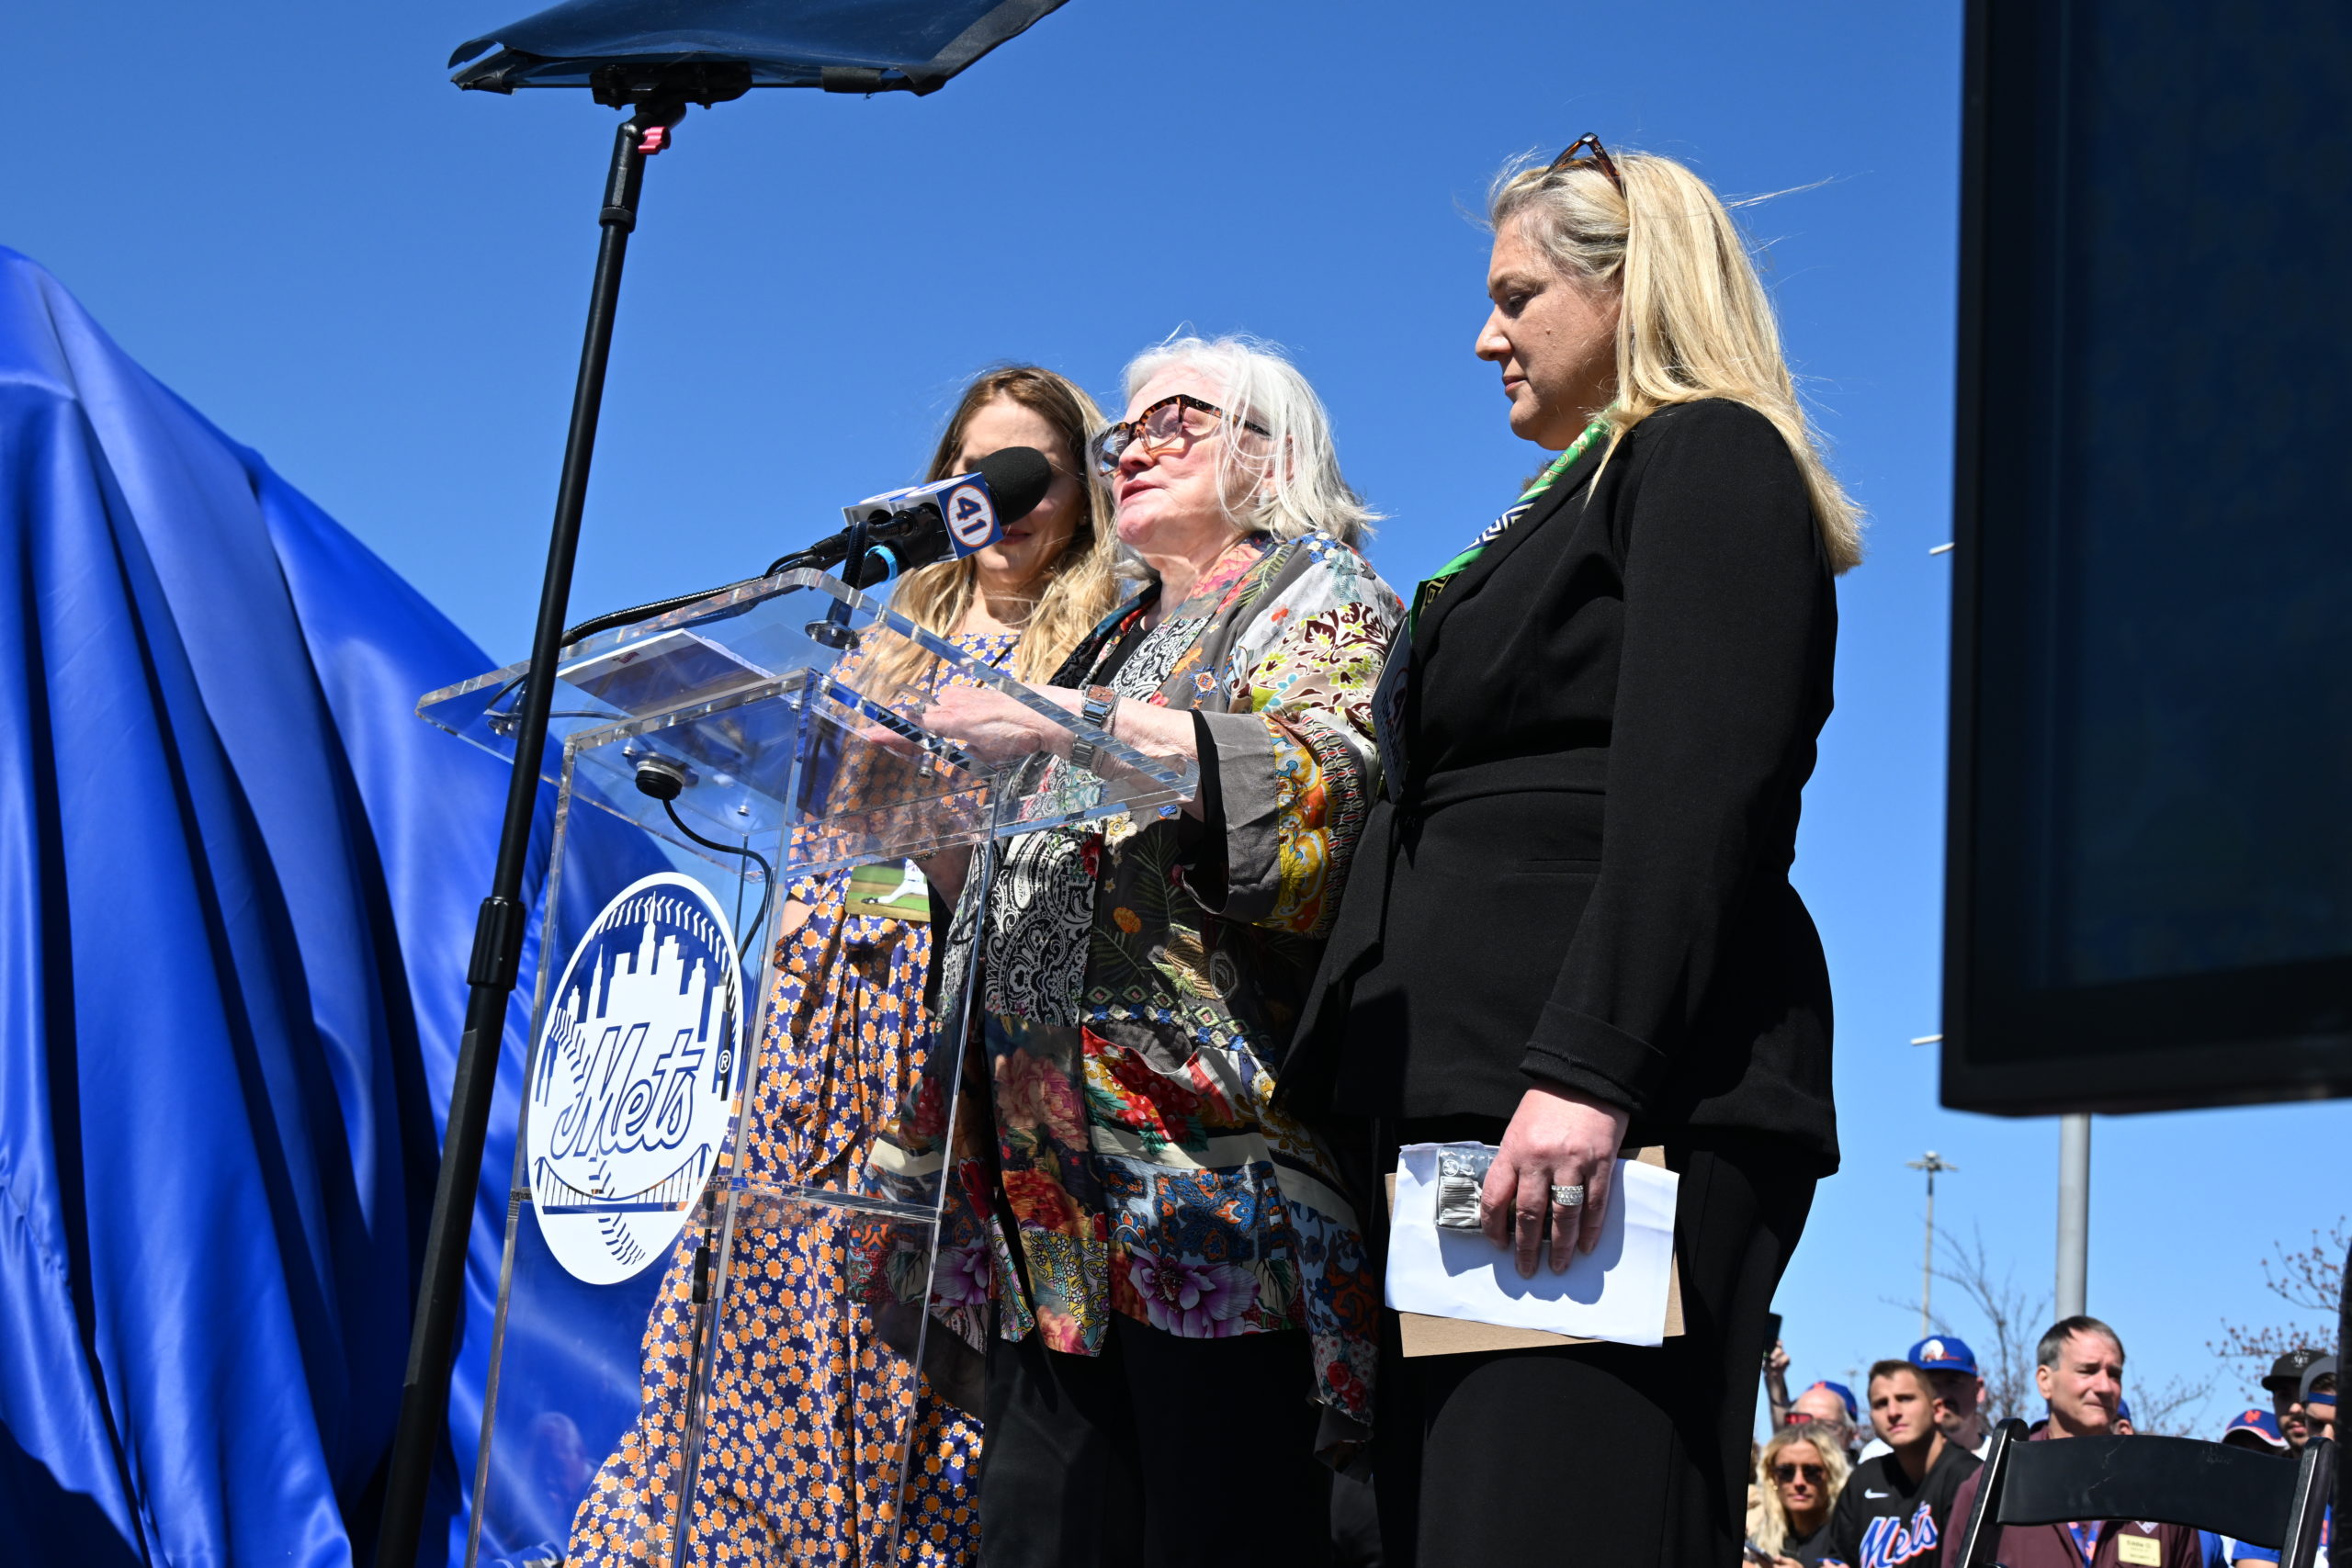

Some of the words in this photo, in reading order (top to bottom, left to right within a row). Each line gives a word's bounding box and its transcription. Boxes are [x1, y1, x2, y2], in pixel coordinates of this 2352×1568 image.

[956, 496, 987, 536] 41
[550, 1021, 706, 1160] Mets
[1859, 1500, 1939, 1568] Mets
